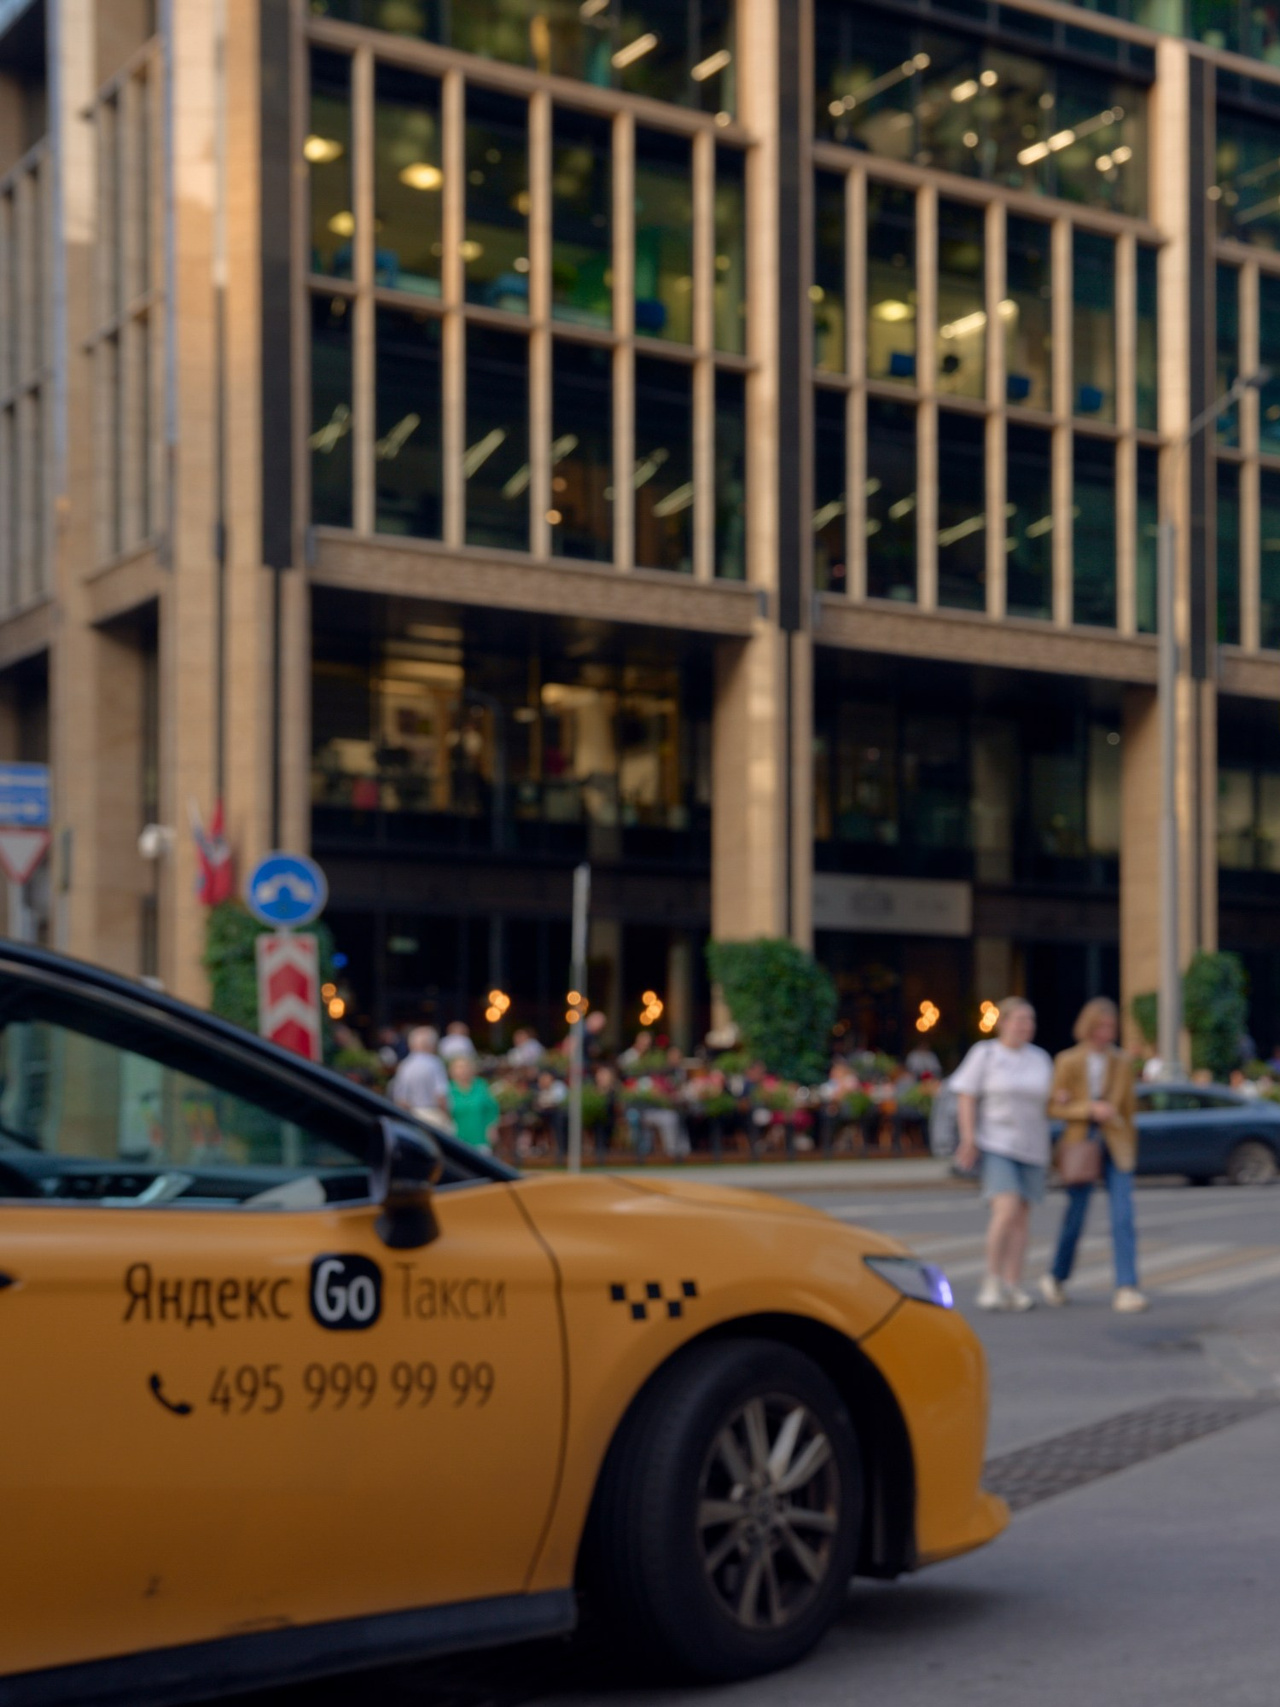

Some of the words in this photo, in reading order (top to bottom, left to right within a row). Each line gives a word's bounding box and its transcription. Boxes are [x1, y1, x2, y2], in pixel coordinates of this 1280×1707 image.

[122, 1262, 293, 1328] Яндекс
[313, 1259, 377, 1322] Go
[396, 1262, 507, 1321] Такси
[207, 1364, 285, 1414] 495
[303, 1361, 379, 1411] 999
[391, 1361, 438, 1410] 99
[449, 1358, 496, 1408] 99
